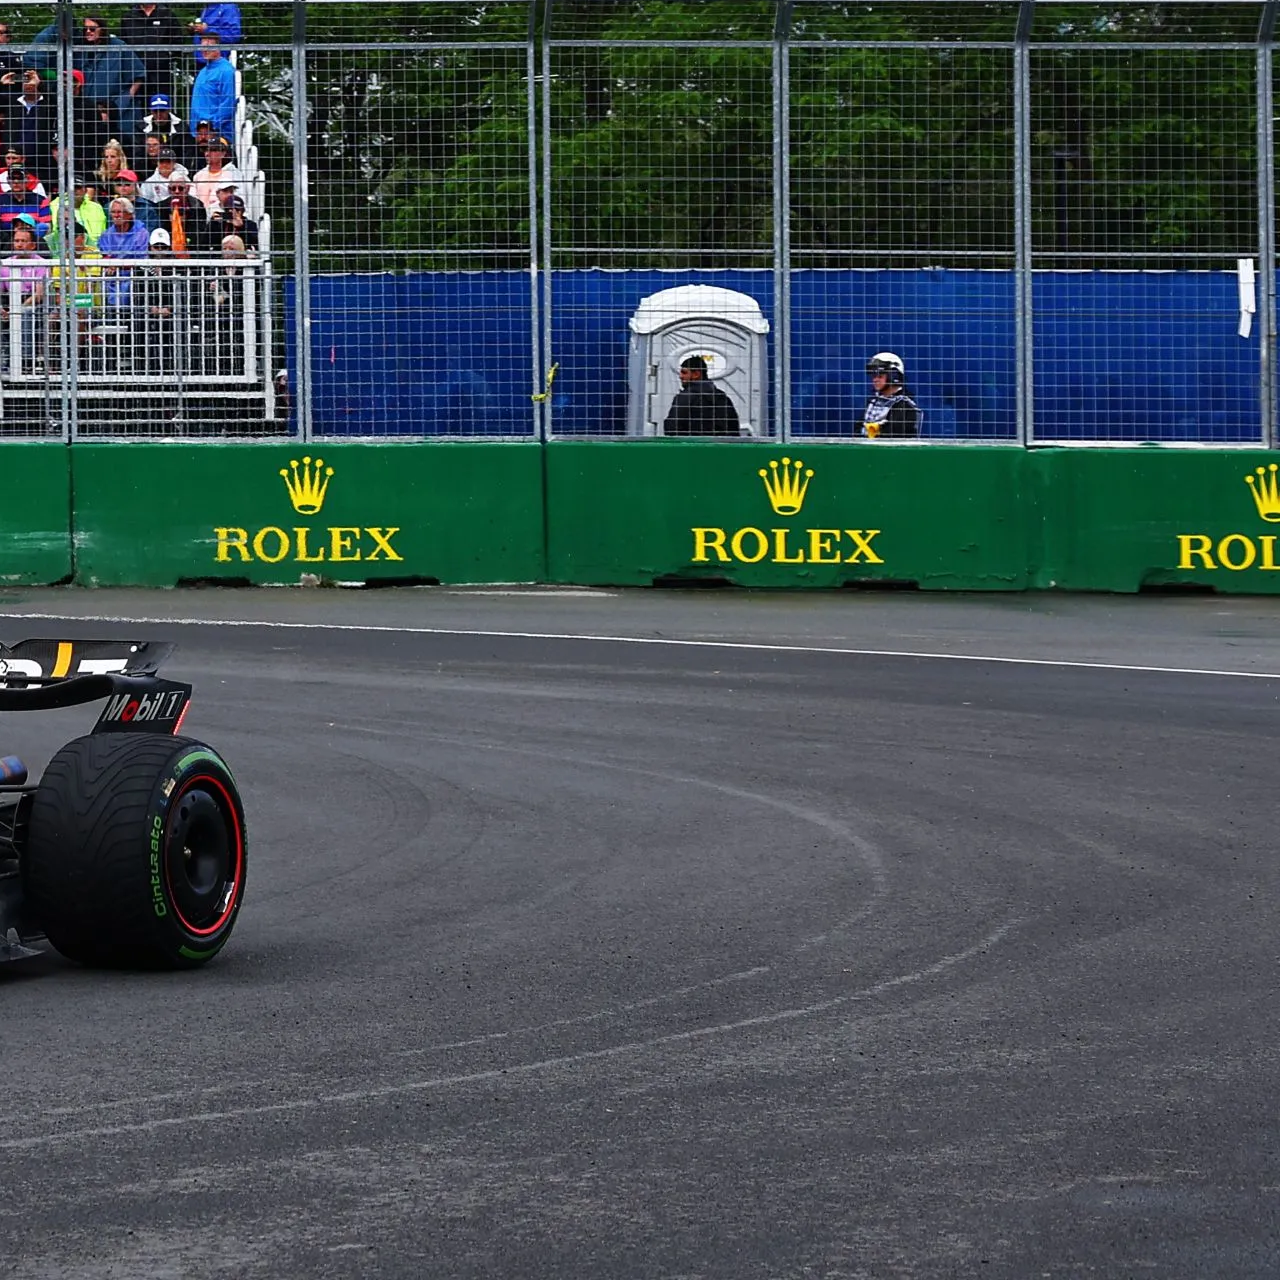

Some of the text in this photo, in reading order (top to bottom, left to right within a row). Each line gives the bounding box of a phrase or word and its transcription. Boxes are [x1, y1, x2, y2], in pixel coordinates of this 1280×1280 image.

[214, 526, 403, 563] ROLEX
[691, 527, 884, 564] ROLEX
[102, 692, 165, 722] Mobil
